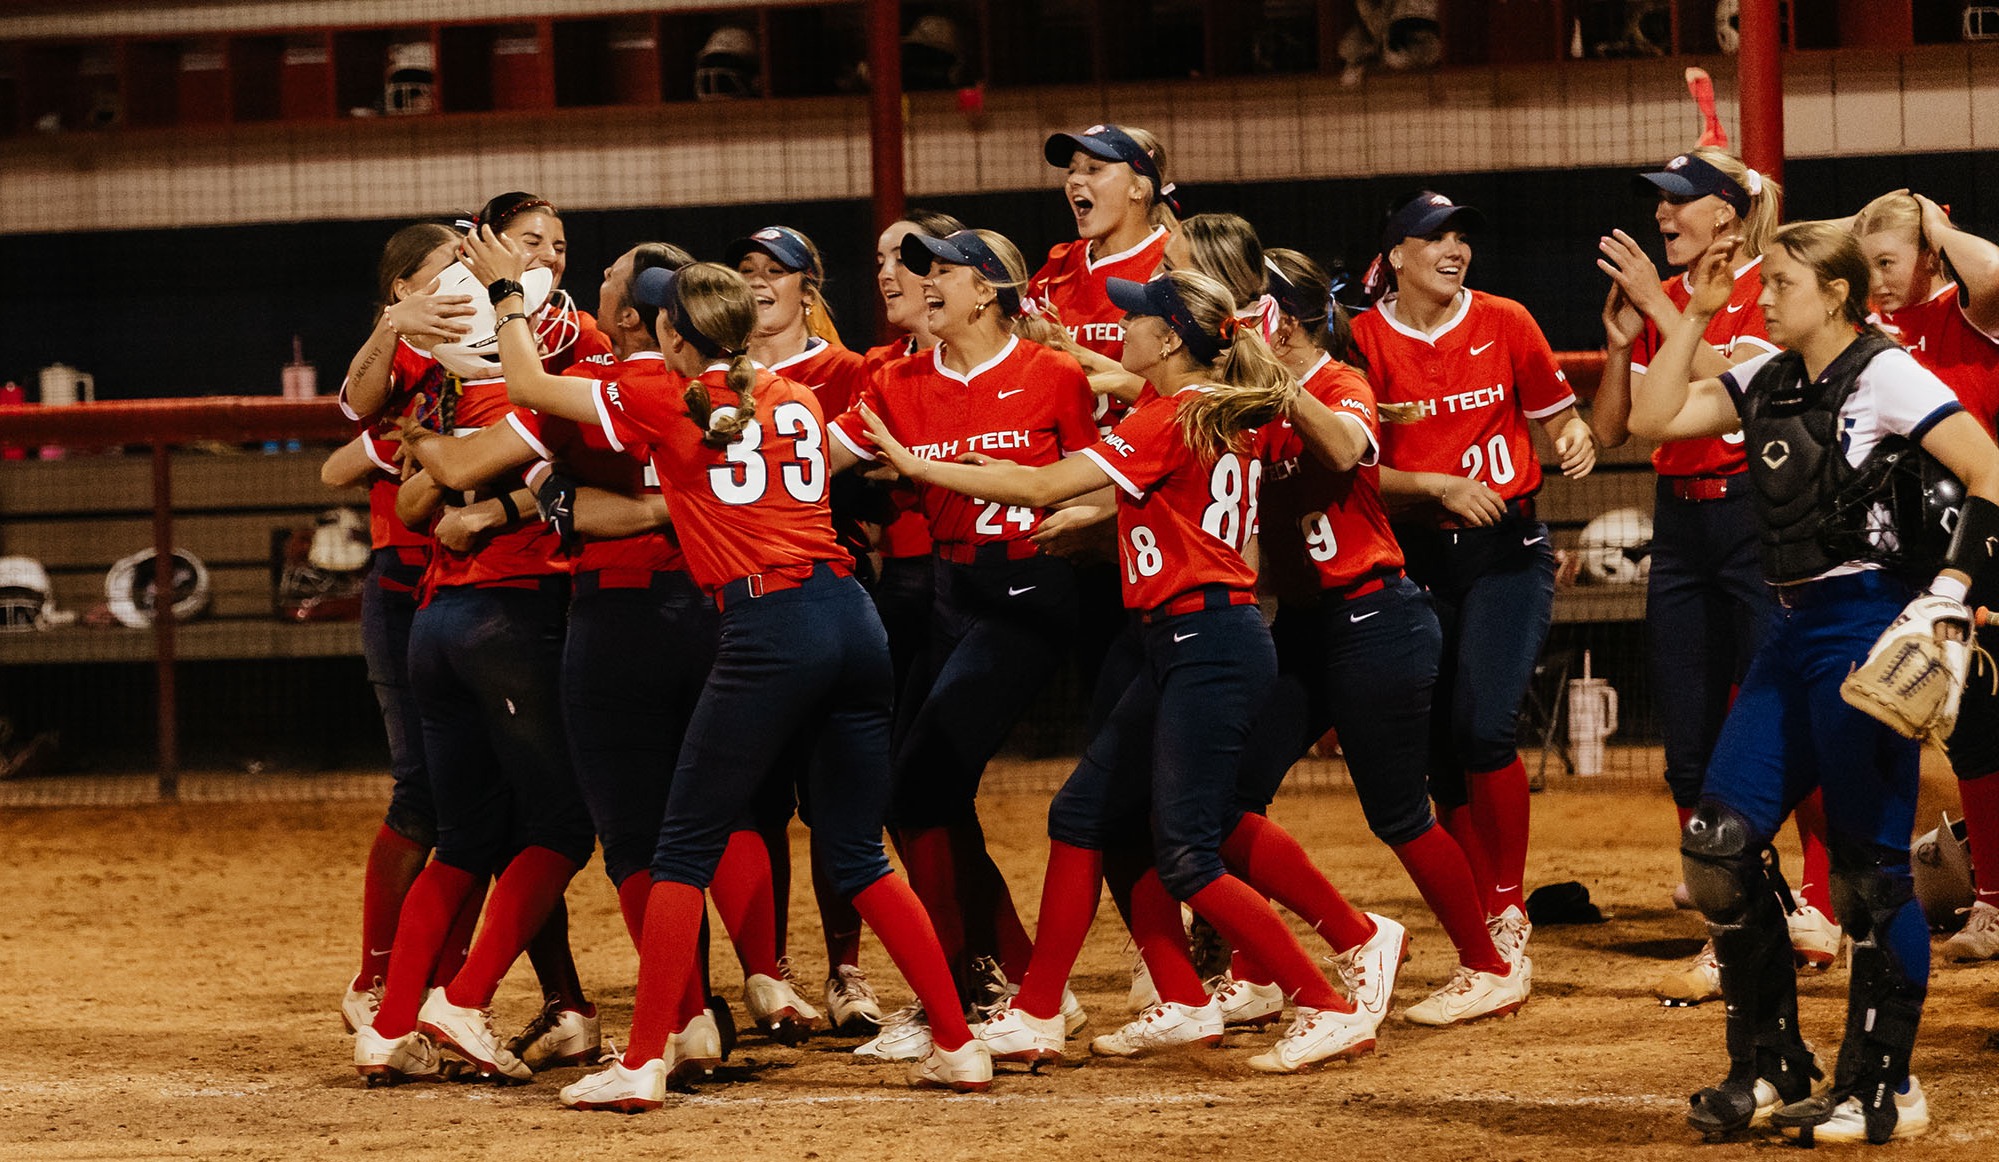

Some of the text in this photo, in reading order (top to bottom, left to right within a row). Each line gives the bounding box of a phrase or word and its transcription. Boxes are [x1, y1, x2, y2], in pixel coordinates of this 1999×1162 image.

[1443, 384, 1505, 413] TECH
[707, 401, 825, 505] 33
[966, 430, 1030, 451] TECH
[1461, 434, 1516, 487] 20
[974, 497, 1035, 535] 24
